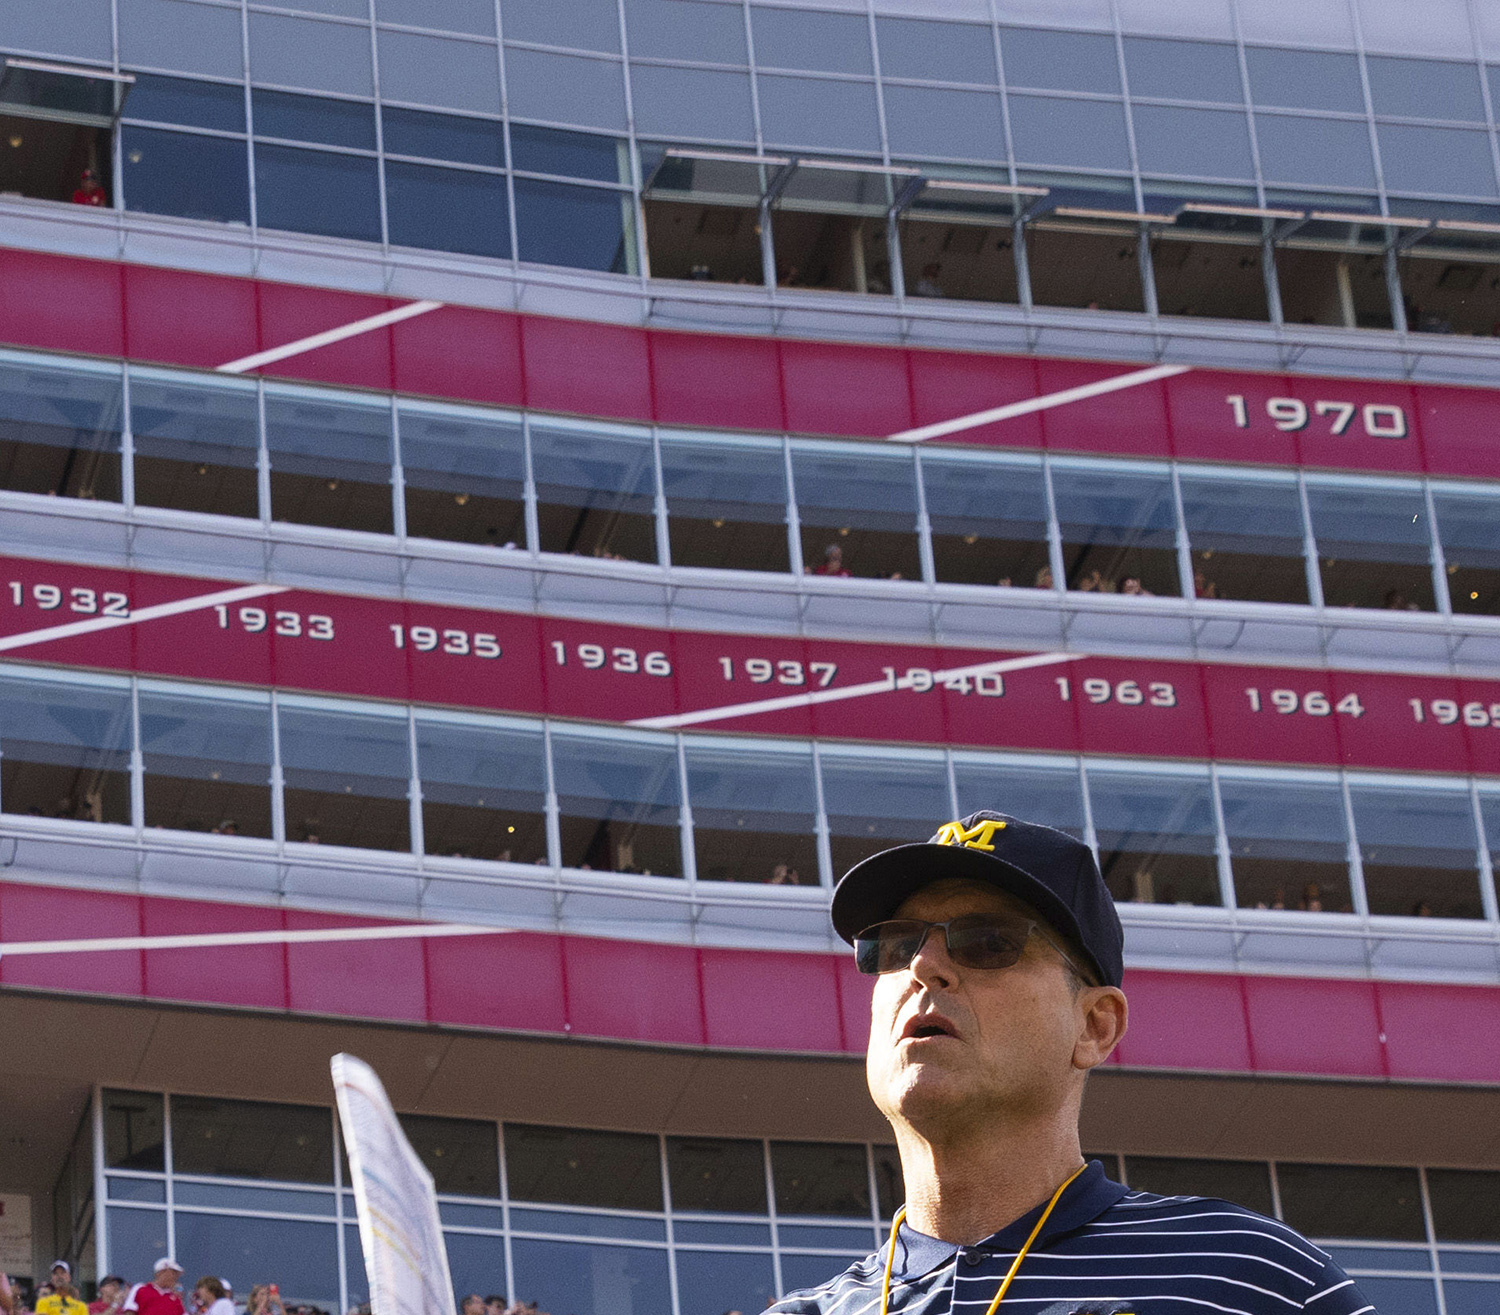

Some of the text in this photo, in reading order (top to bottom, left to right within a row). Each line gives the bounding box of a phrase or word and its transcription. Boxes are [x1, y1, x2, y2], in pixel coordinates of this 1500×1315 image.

[1227, 393, 1408, 440] 1970
[8, 580, 131, 620] 1932
[214, 604, 335, 642] 1933
[391, 623, 503, 659] 1935
[552, 639, 672, 677] 1936
[720, 656, 839, 689] 1937
[882, 665, 1005, 699] 1940
[1056, 677, 1177, 709] 1963
[1243, 685, 1365, 719] 1964
[937, 819, 1006, 852] M
